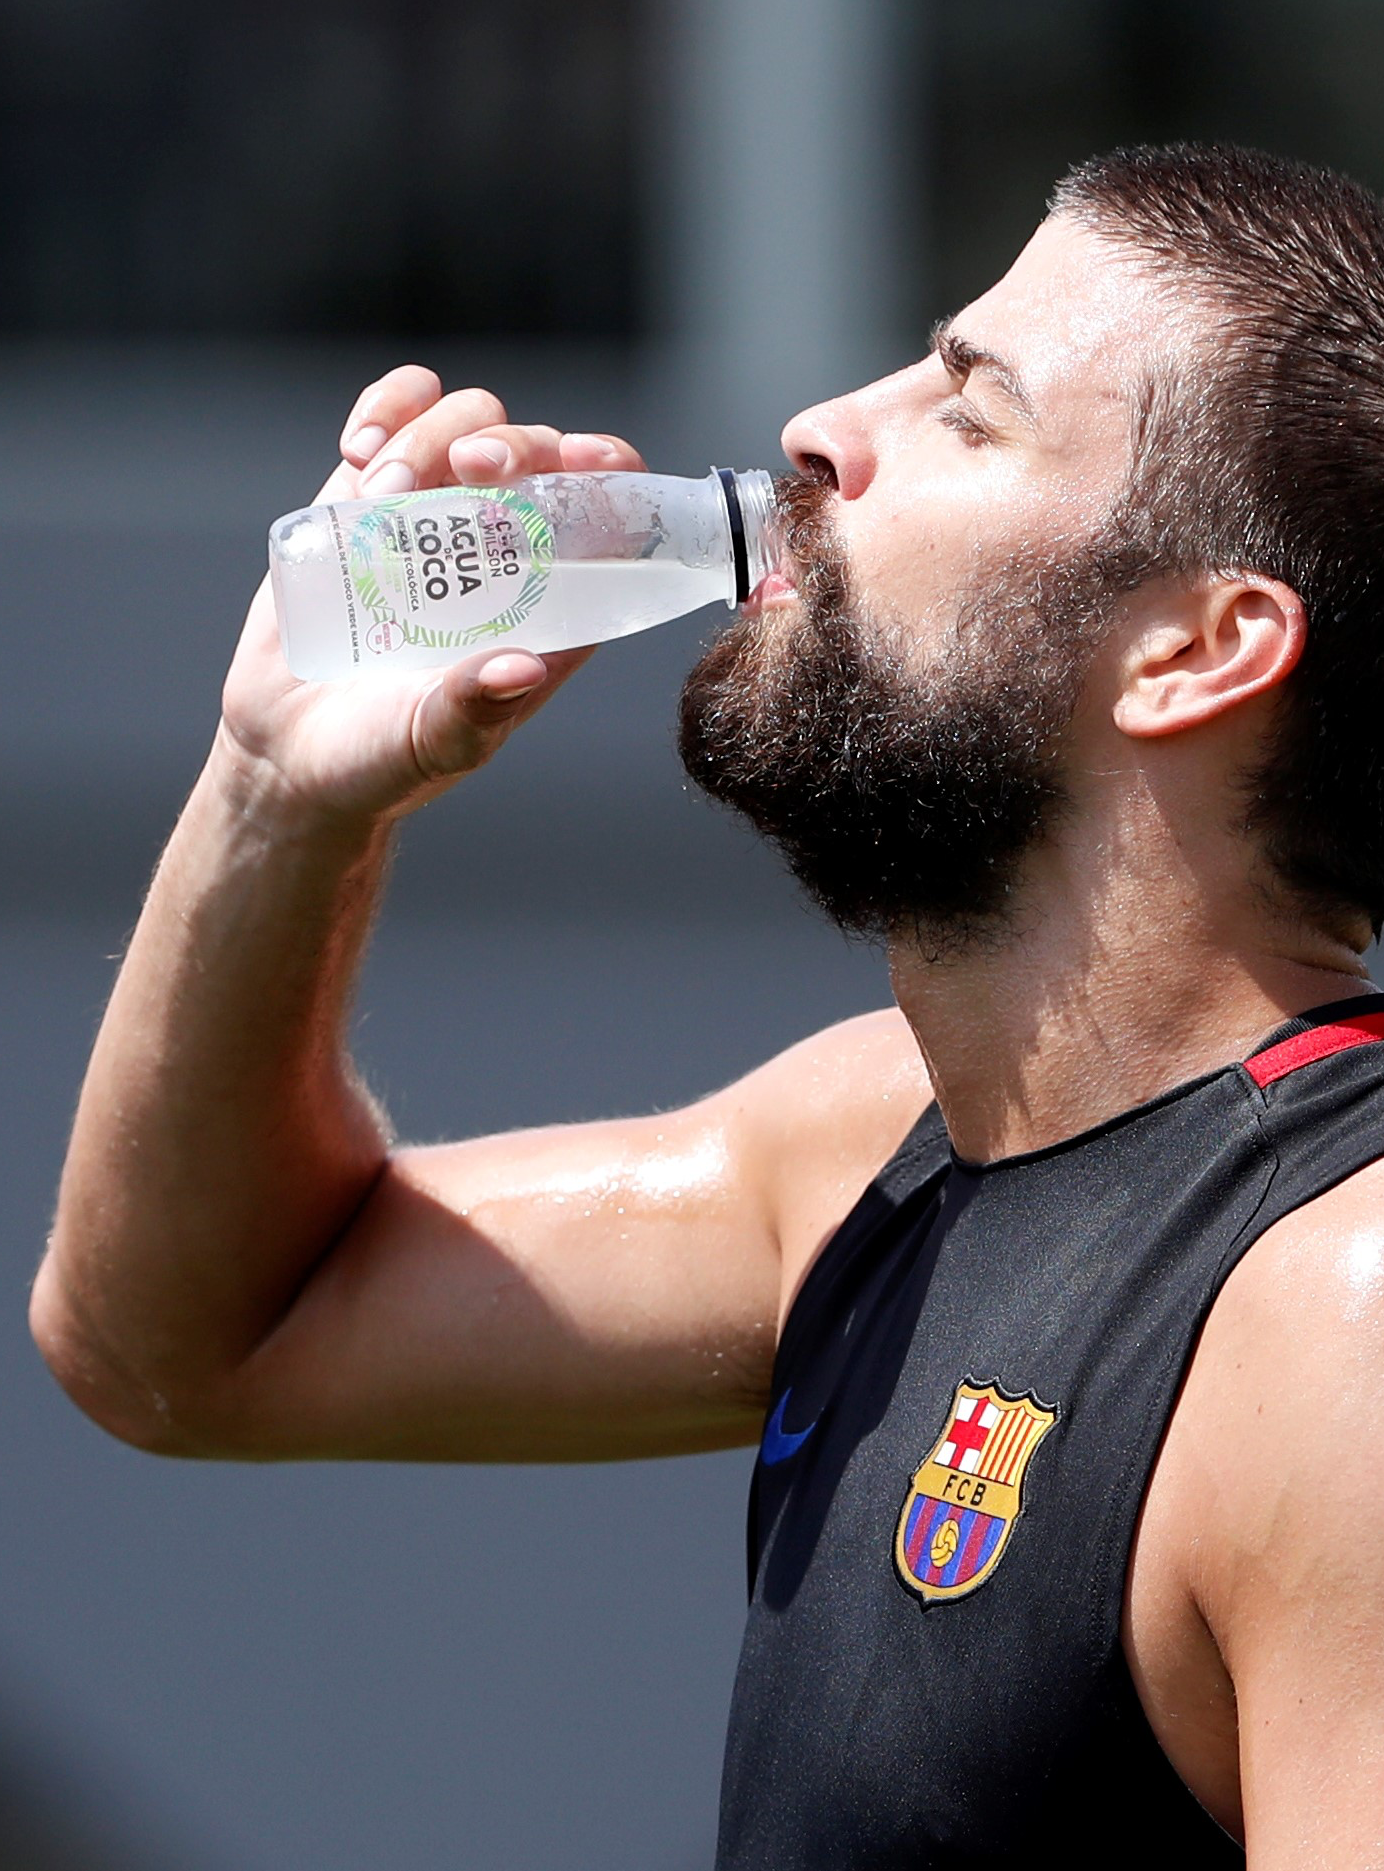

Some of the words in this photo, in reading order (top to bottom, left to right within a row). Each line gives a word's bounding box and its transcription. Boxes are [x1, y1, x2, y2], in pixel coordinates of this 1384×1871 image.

[339, 552, 347, 562] DE
[416, 519, 448, 600] COCO
[444, 548, 453, 560] DE
[447, 515, 482, 596] AGUA
[483, 523, 502, 577] WILSON
[341, 564, 348, 575] UN
[344, 578, 352, 601] COCO
[405, 557, 418, 612] ECOLÓGICA
[347, 602, 356, 629] VERDE
[942, 1475, 987, 1506] FCB
